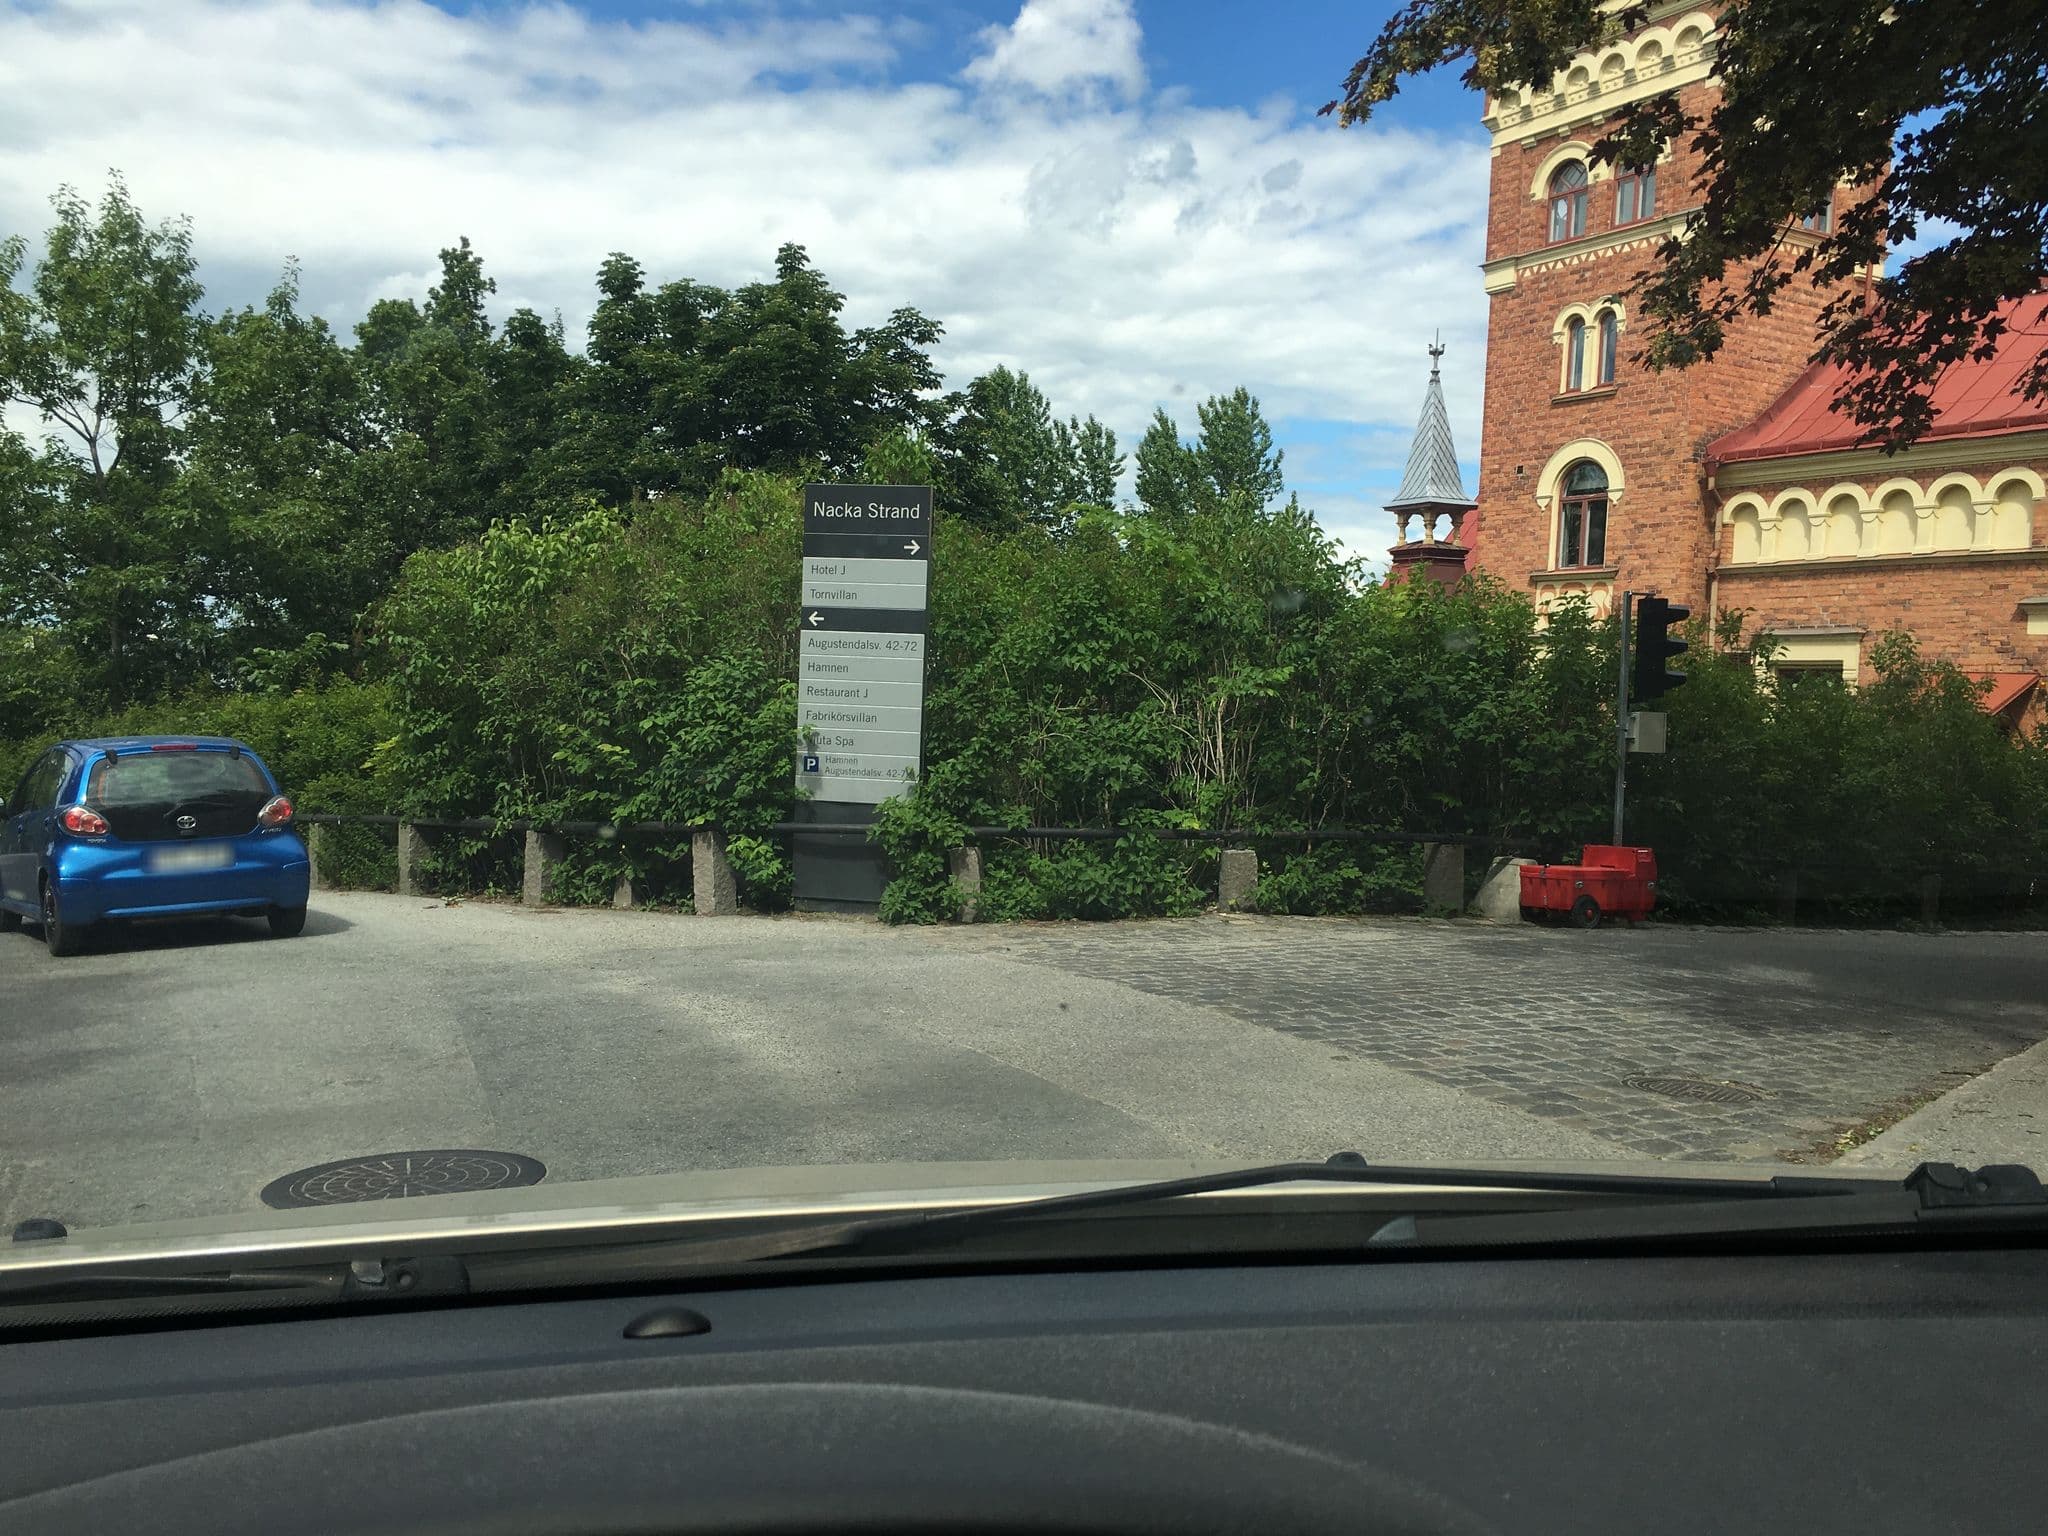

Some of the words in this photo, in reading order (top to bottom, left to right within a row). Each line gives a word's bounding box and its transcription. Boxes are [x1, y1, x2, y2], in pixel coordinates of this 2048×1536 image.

[813, 501, 862, 518] Nacka
[868, 502, 920, 519] Strand
[811, 564, 838, 575] Hotel
[841, 565, 846, 575] J
[810, 588, 858, 600] Tornvillan
[807, 638, 882, 651] Augustendalsv.
[885, 640, 918, 652] 42-72
[807, 662, 849, 673] Hamnen
[806, 685, 860, 698] Restaurant
[863, 688, 869, 698] J
[834, 735, 855, 748] Spa
[807, 758, 816, 770] P
[825, 756, 859, 765] Hamnen
[886, 769, 912, 779] 42-7
